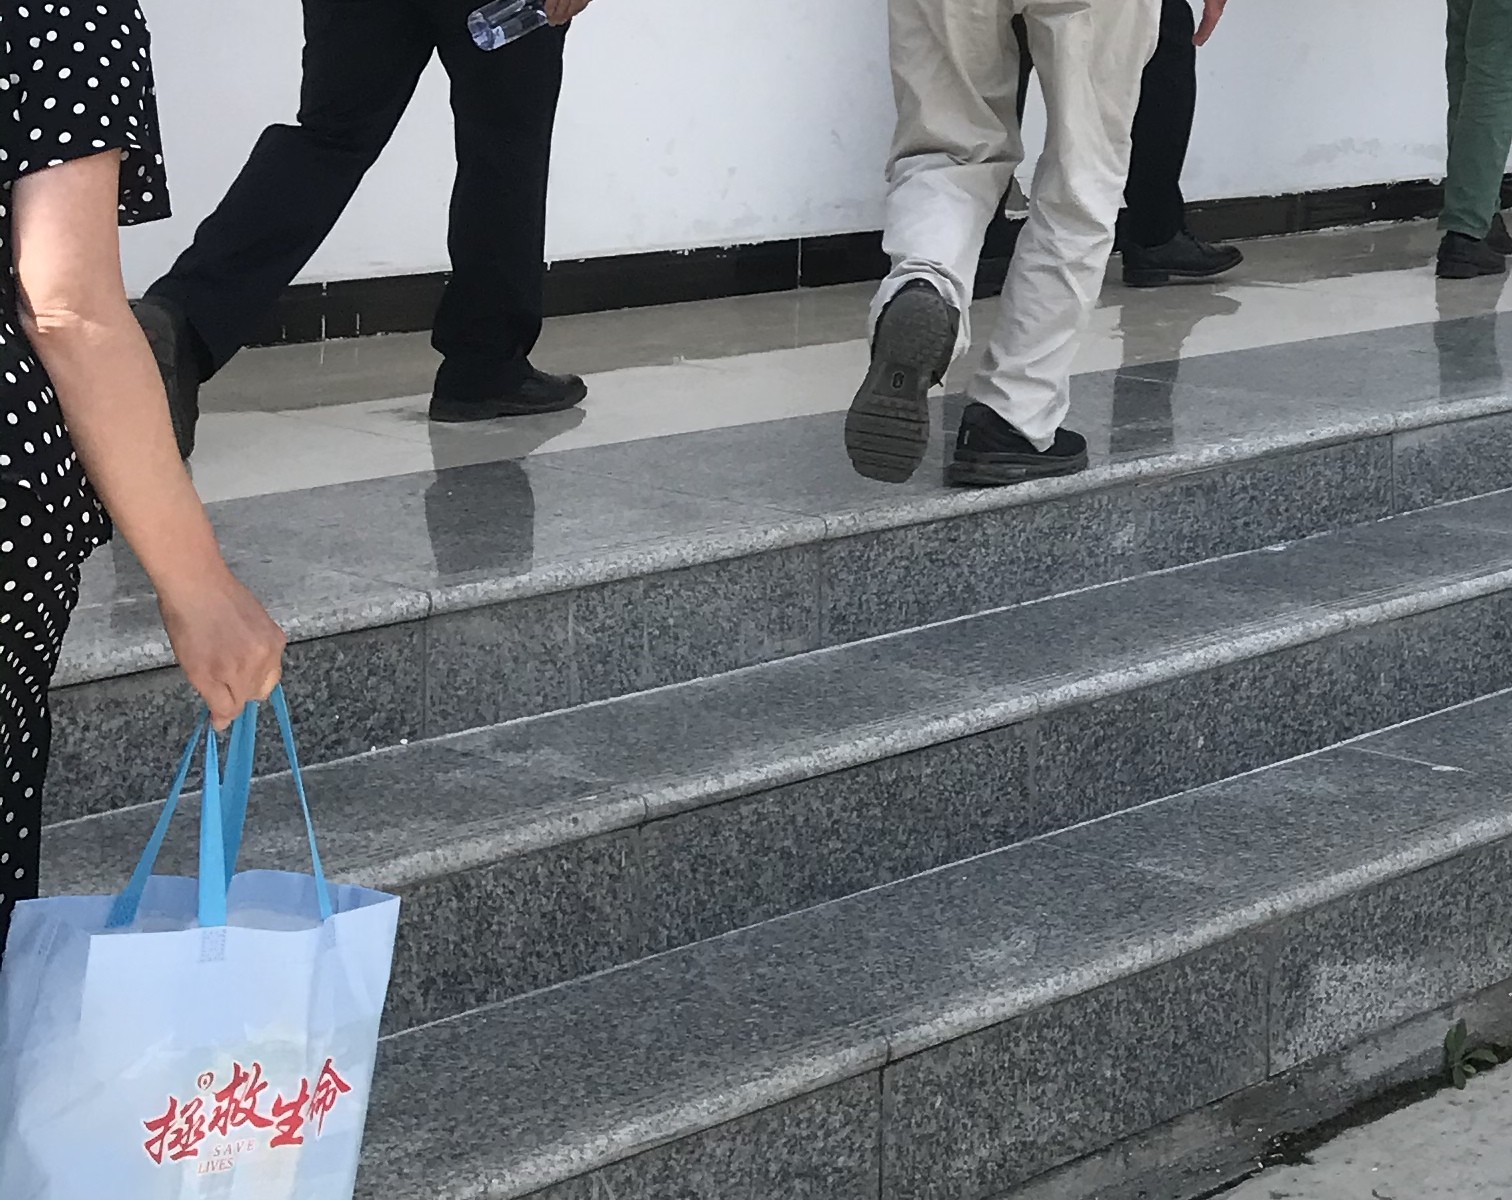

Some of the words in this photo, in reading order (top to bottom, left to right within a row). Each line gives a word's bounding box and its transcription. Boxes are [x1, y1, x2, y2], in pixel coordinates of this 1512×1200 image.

[143, 1057, 352, 1165] 拯救生命
[212, 1140, 255, 1157] SAVE
[197, 1157, 234, 1174] LIVES
